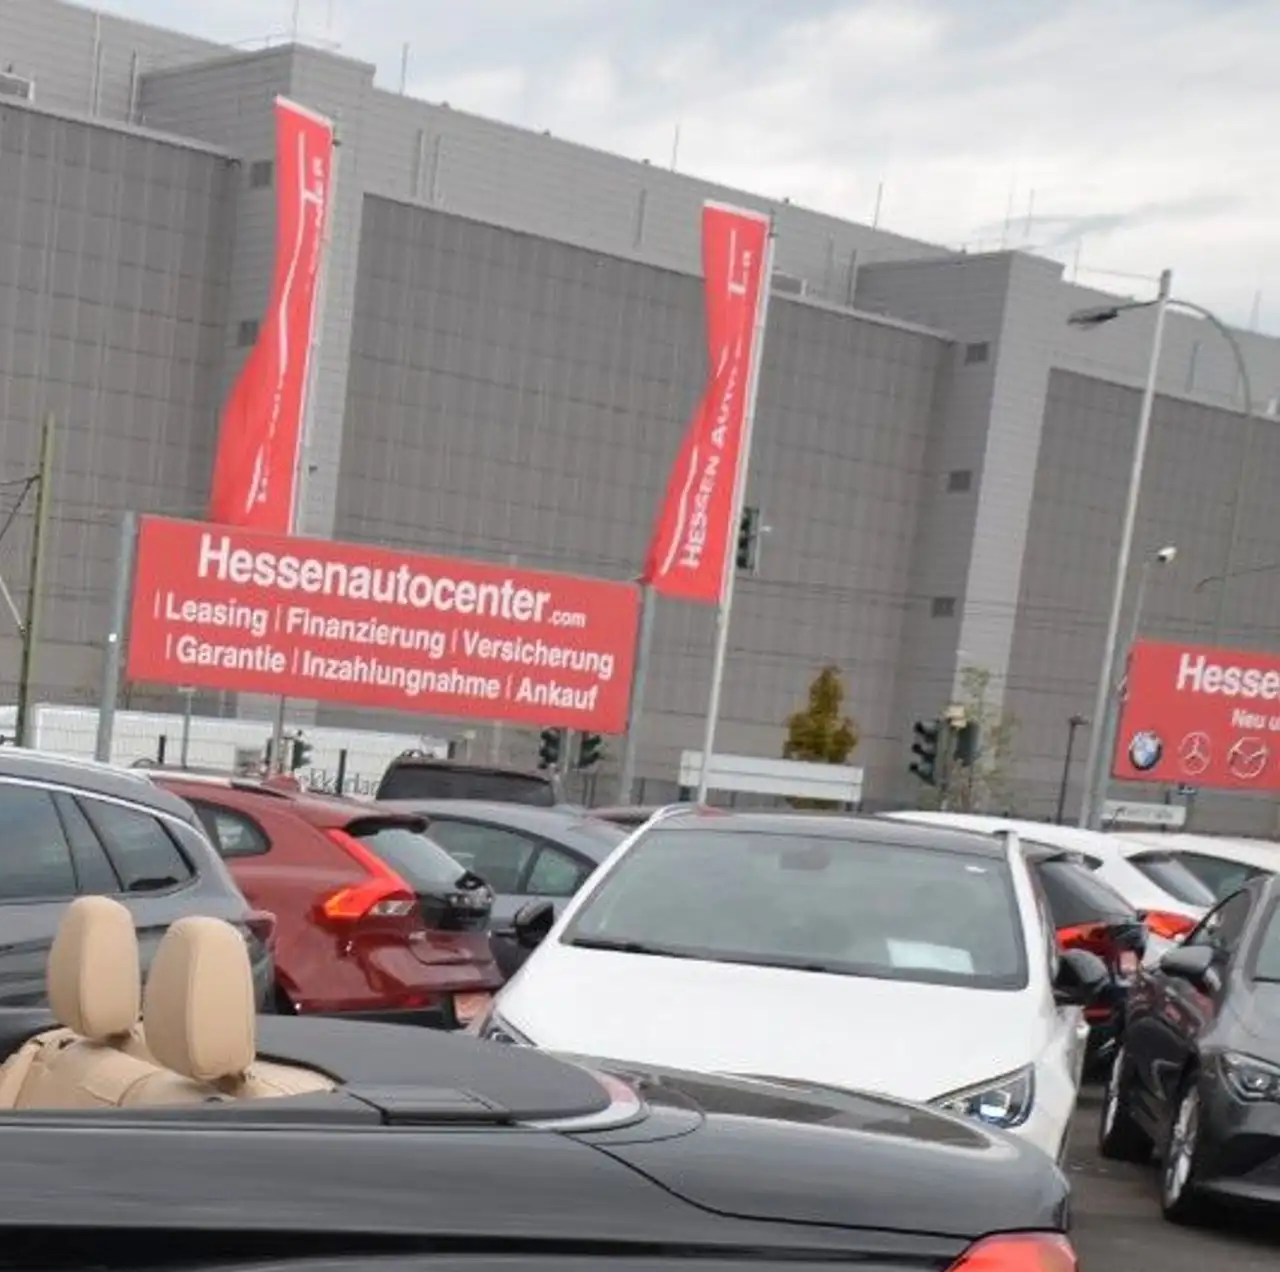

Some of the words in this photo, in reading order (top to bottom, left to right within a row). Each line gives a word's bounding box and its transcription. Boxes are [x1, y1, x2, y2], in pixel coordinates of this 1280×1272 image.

[679, 456, 721, 568] HESSEN
[166, 592, 270, 637] Leasing
[287, 606, 446, 659] Finanzierung
[462, 628, 614, 680] Versicherung
[176, 634, 287, 673] Garantie
[302, 649, 500, 698] Inzahlungnahme
[515, 677, 598, 710] Ankauf
[1176, 653, 1280, 700] Hesse
